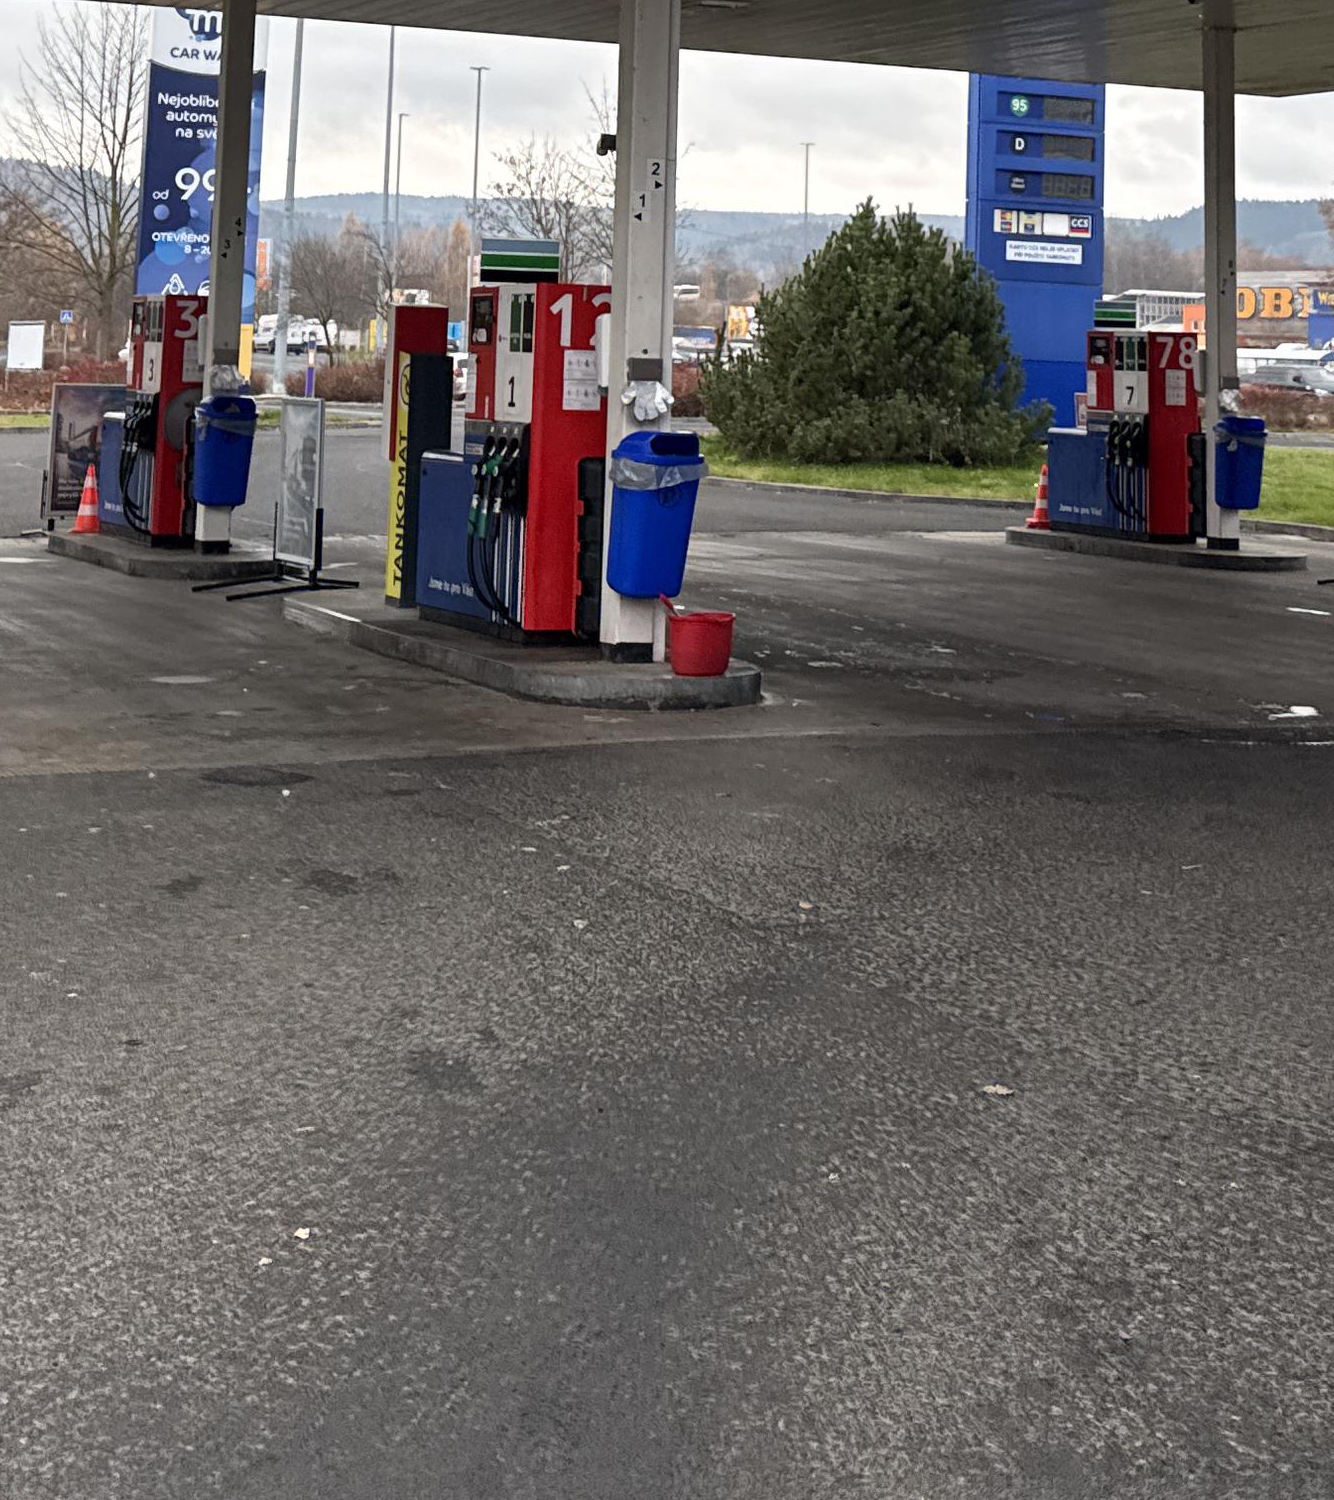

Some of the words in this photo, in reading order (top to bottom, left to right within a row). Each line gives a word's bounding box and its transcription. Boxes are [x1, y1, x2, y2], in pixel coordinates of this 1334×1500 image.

[170, 46, 200, 61] CAR
[1011, 98, 1028, 112] 95
[175, 128, 193, 139] na
[1014, 137, 1025, 151] D
[651, 162, 660, 176] 2
[151, 188, 170, 201] od
[639, 193, 646, 208] 1
[1070, 218, 1089, 228] CCS
[151, 231, 210, 244] OTEVŘENO
[1155, 336, 1197, 369] 78
[147, 358, 155, 381] 3
[508, 376, 516, 408] 1
[1125, 386, 1135, 405] 7
